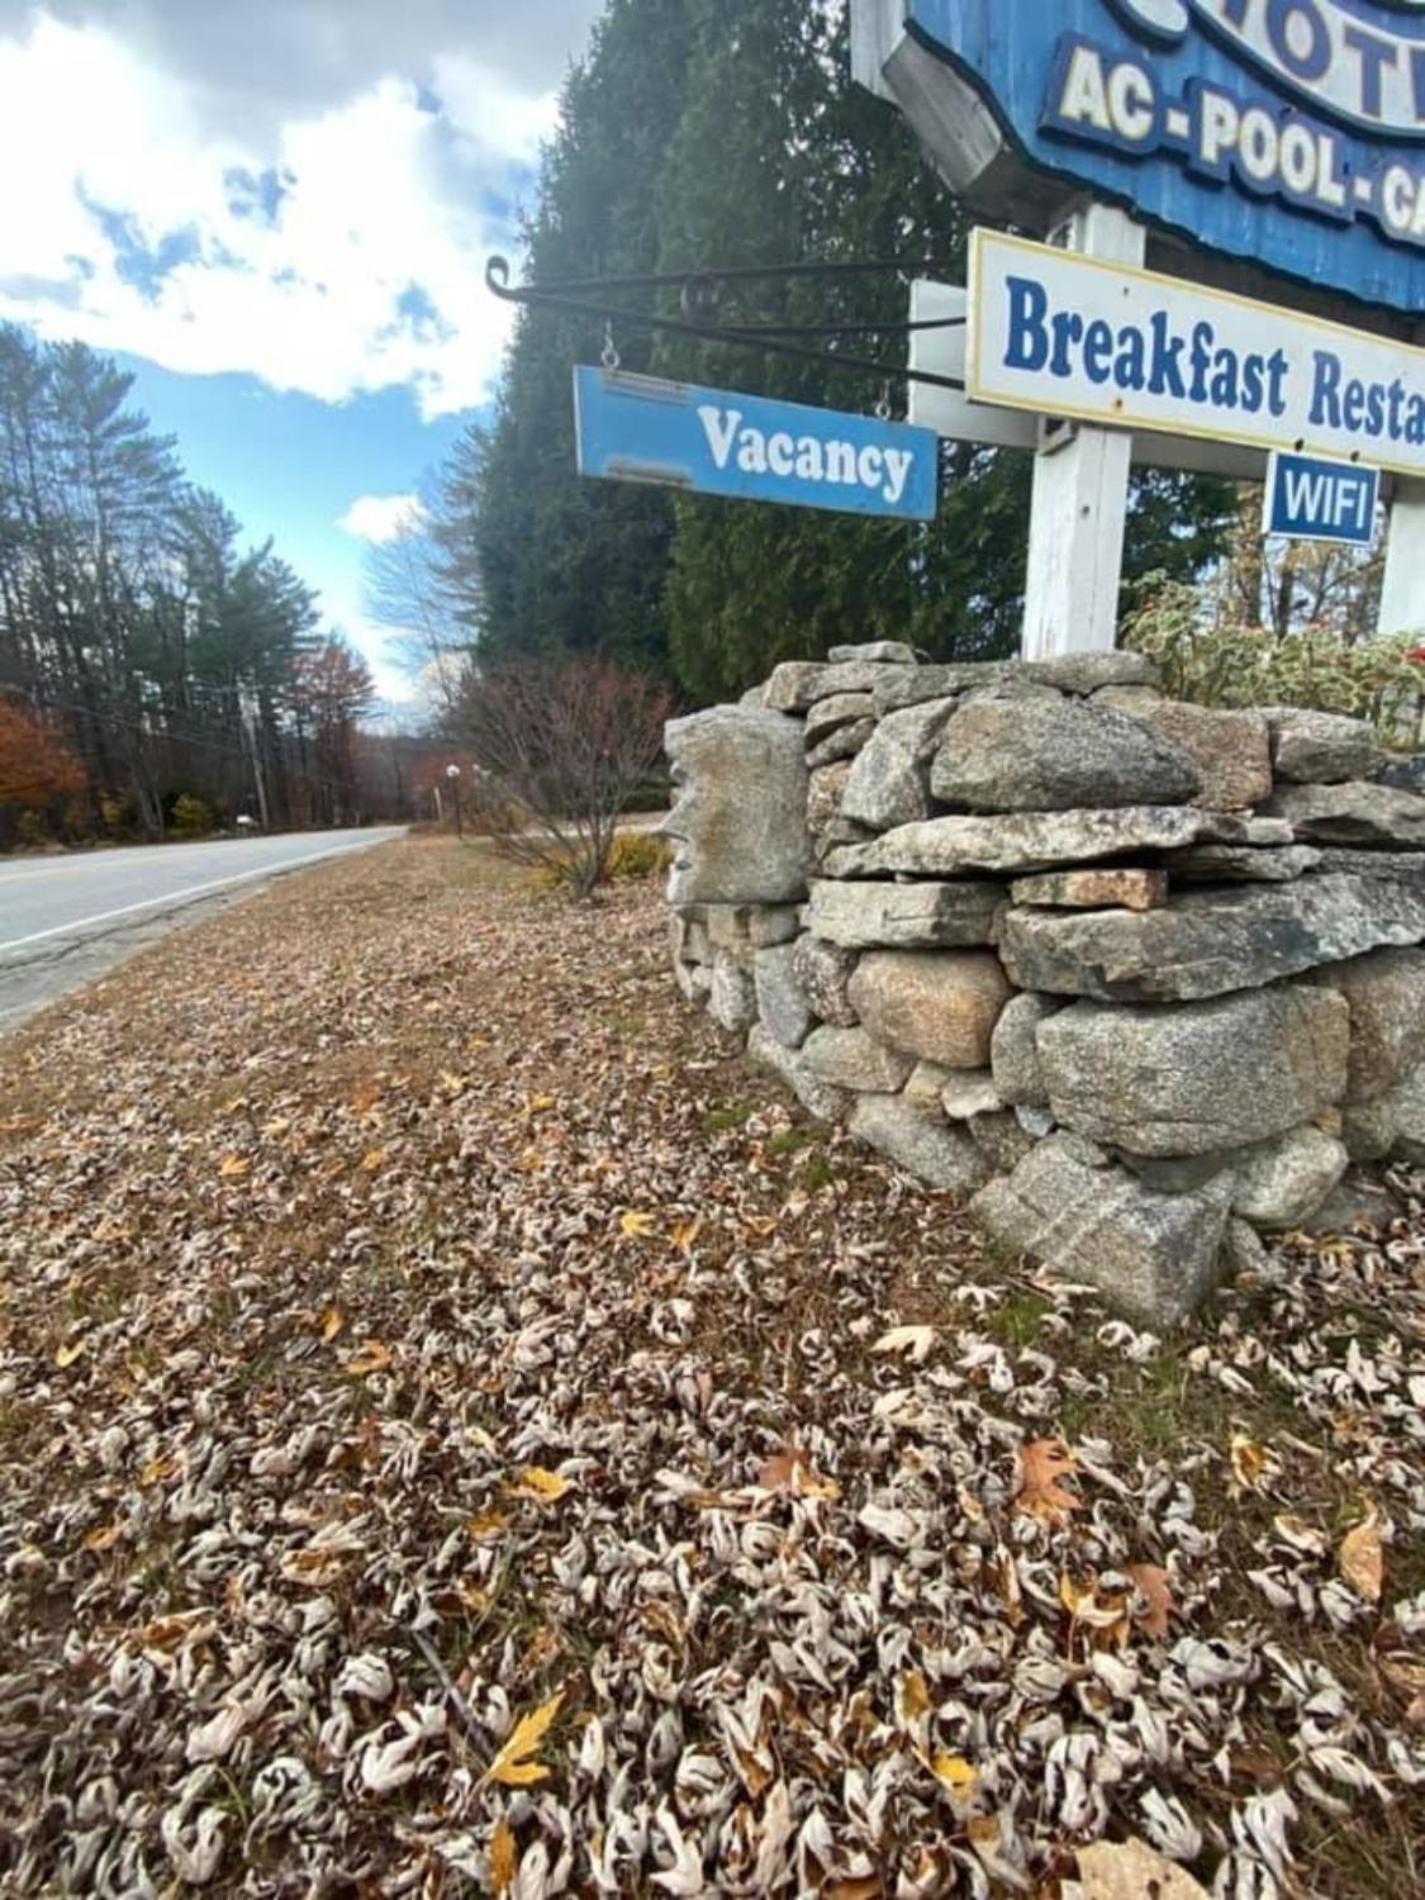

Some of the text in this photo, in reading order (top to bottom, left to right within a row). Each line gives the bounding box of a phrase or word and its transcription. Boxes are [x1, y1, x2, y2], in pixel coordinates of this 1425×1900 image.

[1221, 0, 1425, 122] OT
[1003, 275, 1425, 446] Breakfast Resta
[697, 406, 914, 503] Vacancy
[1283, 468, 1369, 530] WIFI
